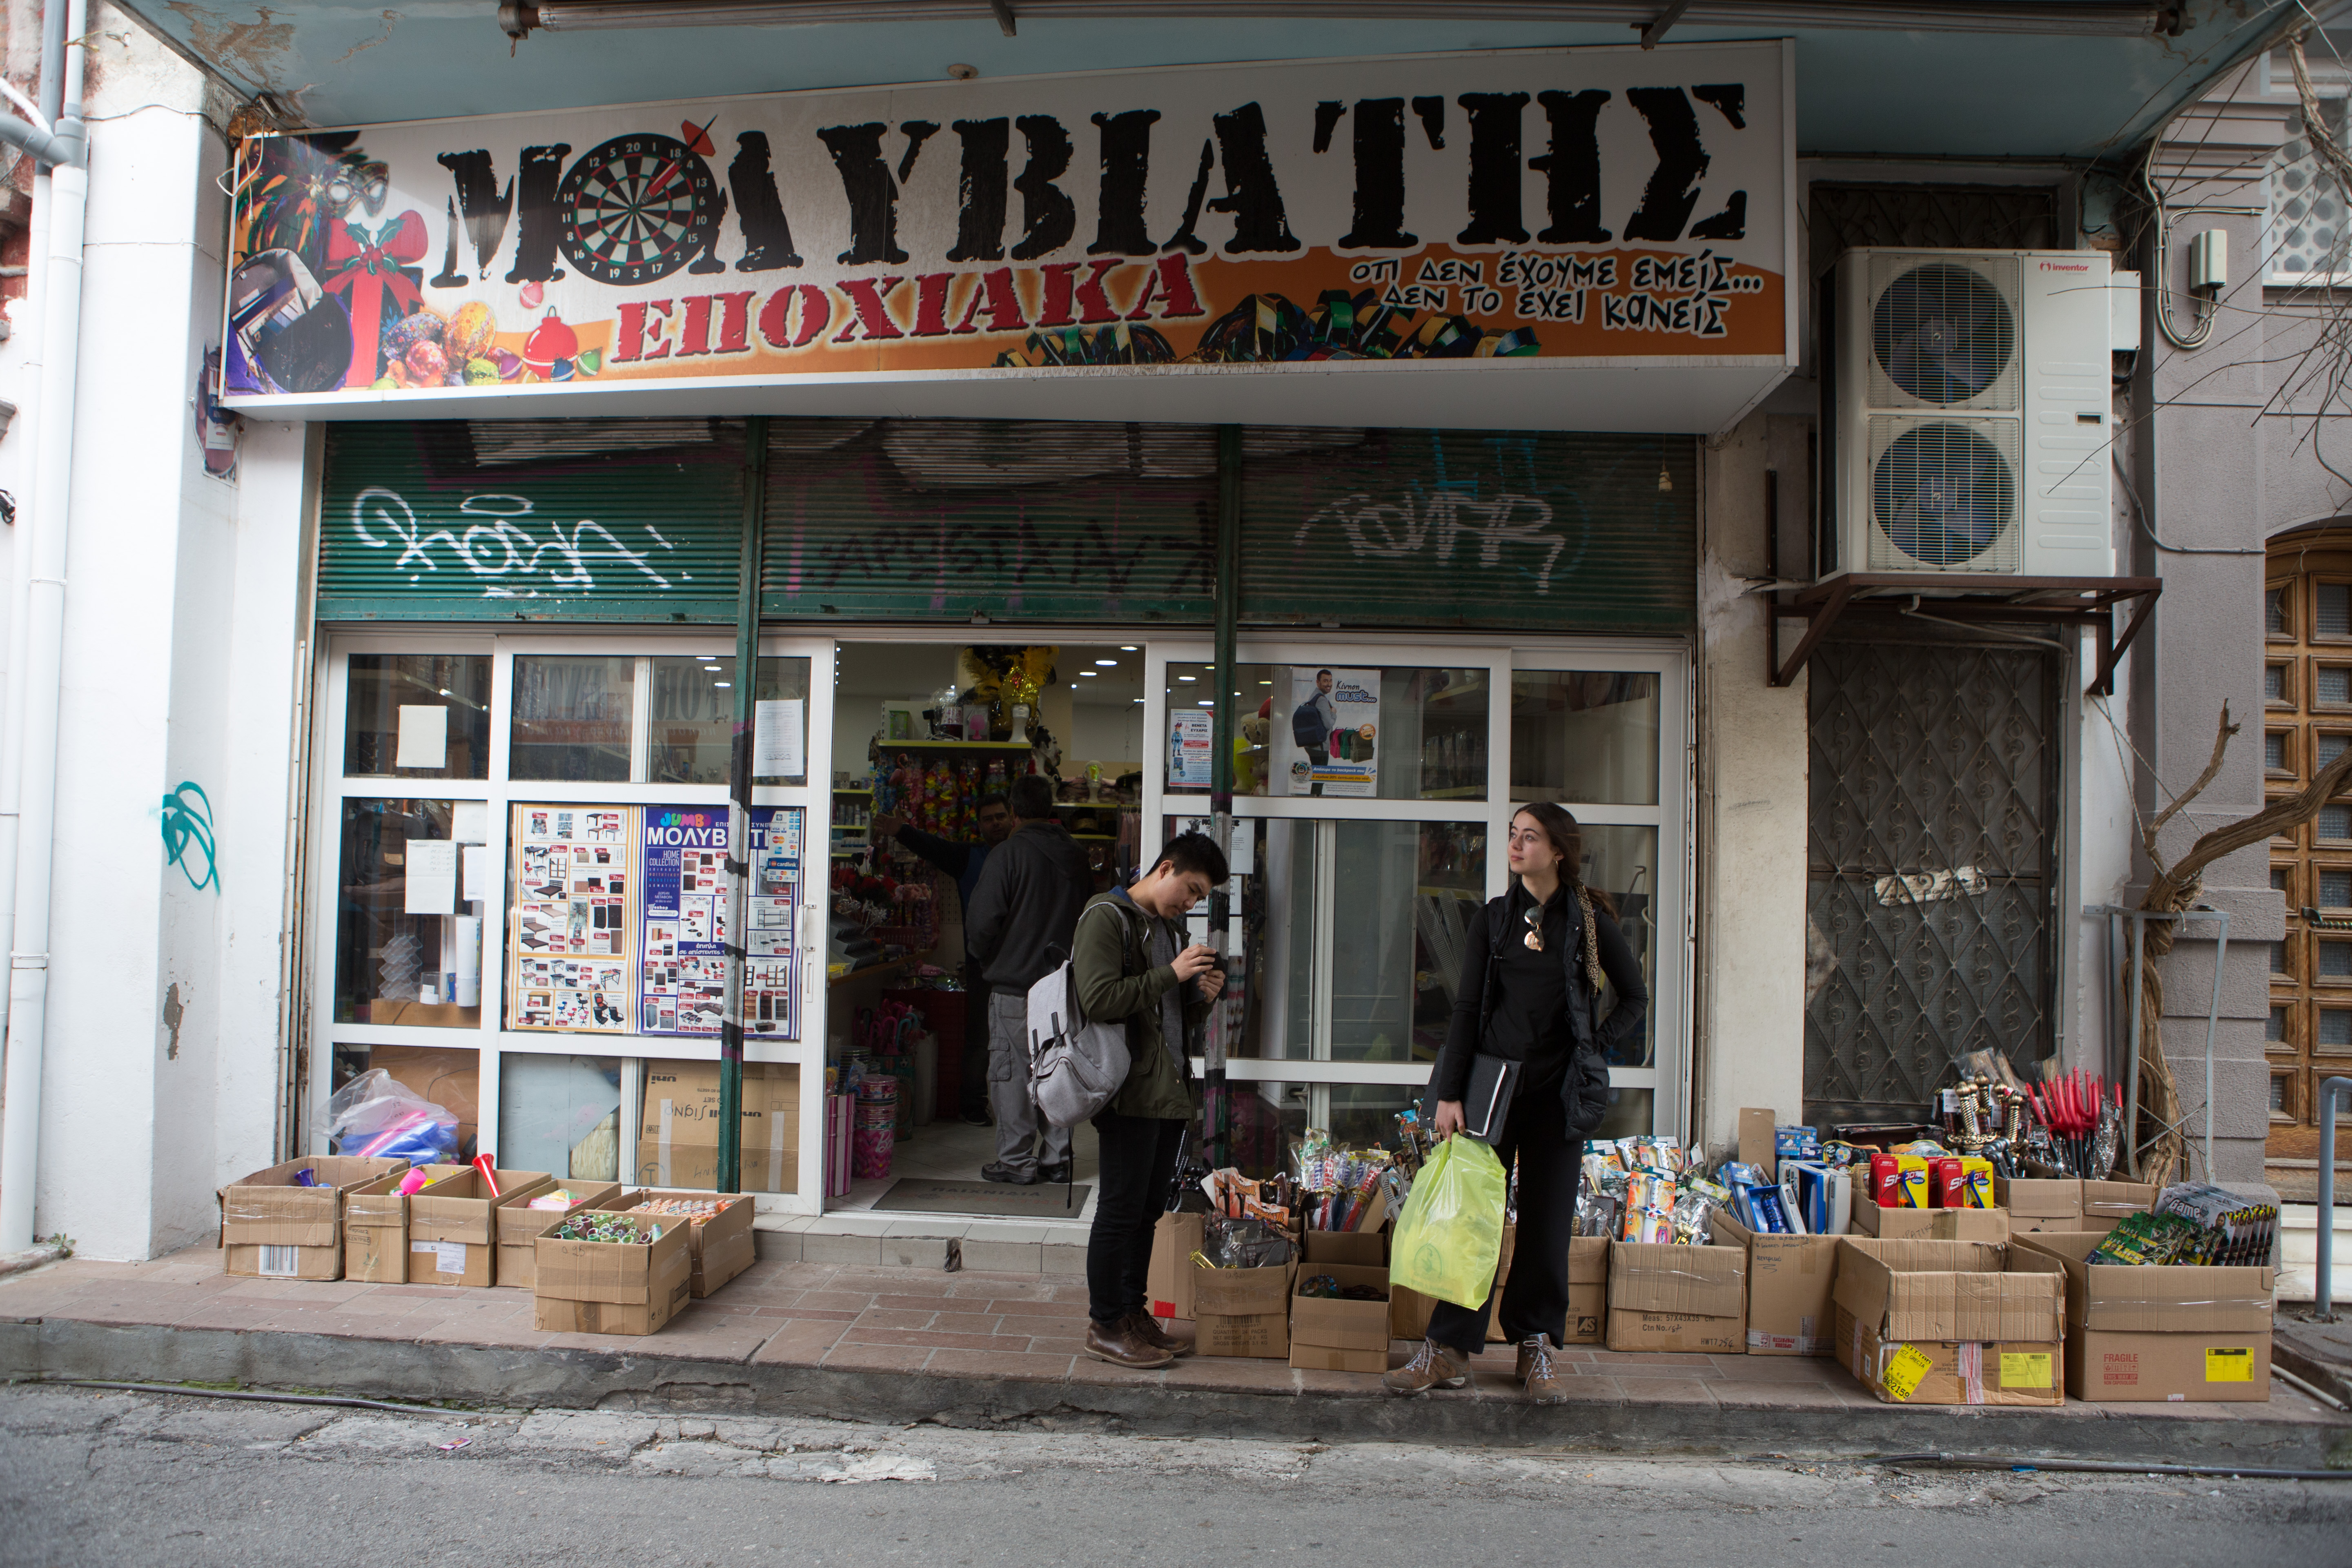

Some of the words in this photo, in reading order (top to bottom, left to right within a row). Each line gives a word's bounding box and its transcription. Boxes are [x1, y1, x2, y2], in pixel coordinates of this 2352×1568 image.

[626, 143, 640, 152] 20
[653, 143, 656, 151] 1
[610, 148, 616, 157] 5
[670, 149, 681, 158] 18
[589, 157, 599, 167] 12
[686, 160, 694, 169] 4
[575, 176, 582, 185] 9
[697, 178, 707, 187] 13
[564, 193, 574, 203] 14
[699, 196, 706, 205] 6
[562, 214, 571, 223] 11
[697, 216, 707, 225] 10
[567, 232, 574, 241] 8
[688, 234, 698, 243] 15
[574, 250, 585, 260] 16
[674, 252, 681, 261] 2
[591, 262, 598, 271] 7
[652, 263, 663, 274] 17
[2053, 264, 2089, 272] inventor
[610, 269, 620, 278] 19
[633, 269, 640, 278] 3
[611, 252, 1206, 363] ΕΠΟΧΙΑΚΑ
[660, 813, 711, 827] JUMBO
[649, 858, 679, 866] COLLECTION
[651, 1076, 677, 1084] uni
[1248, 1203, 1285, 1223] DINOSAUR
[2168, 1198, 2201, 1219] Game
[1578, 1318, 1596, 1331] AS
[1904, 1343, 1932, 1365] SITTAM
[2104, 1354, 2138, 1362] FRAGILE
[1909, 1354, 1925, 1368] GRECIA
